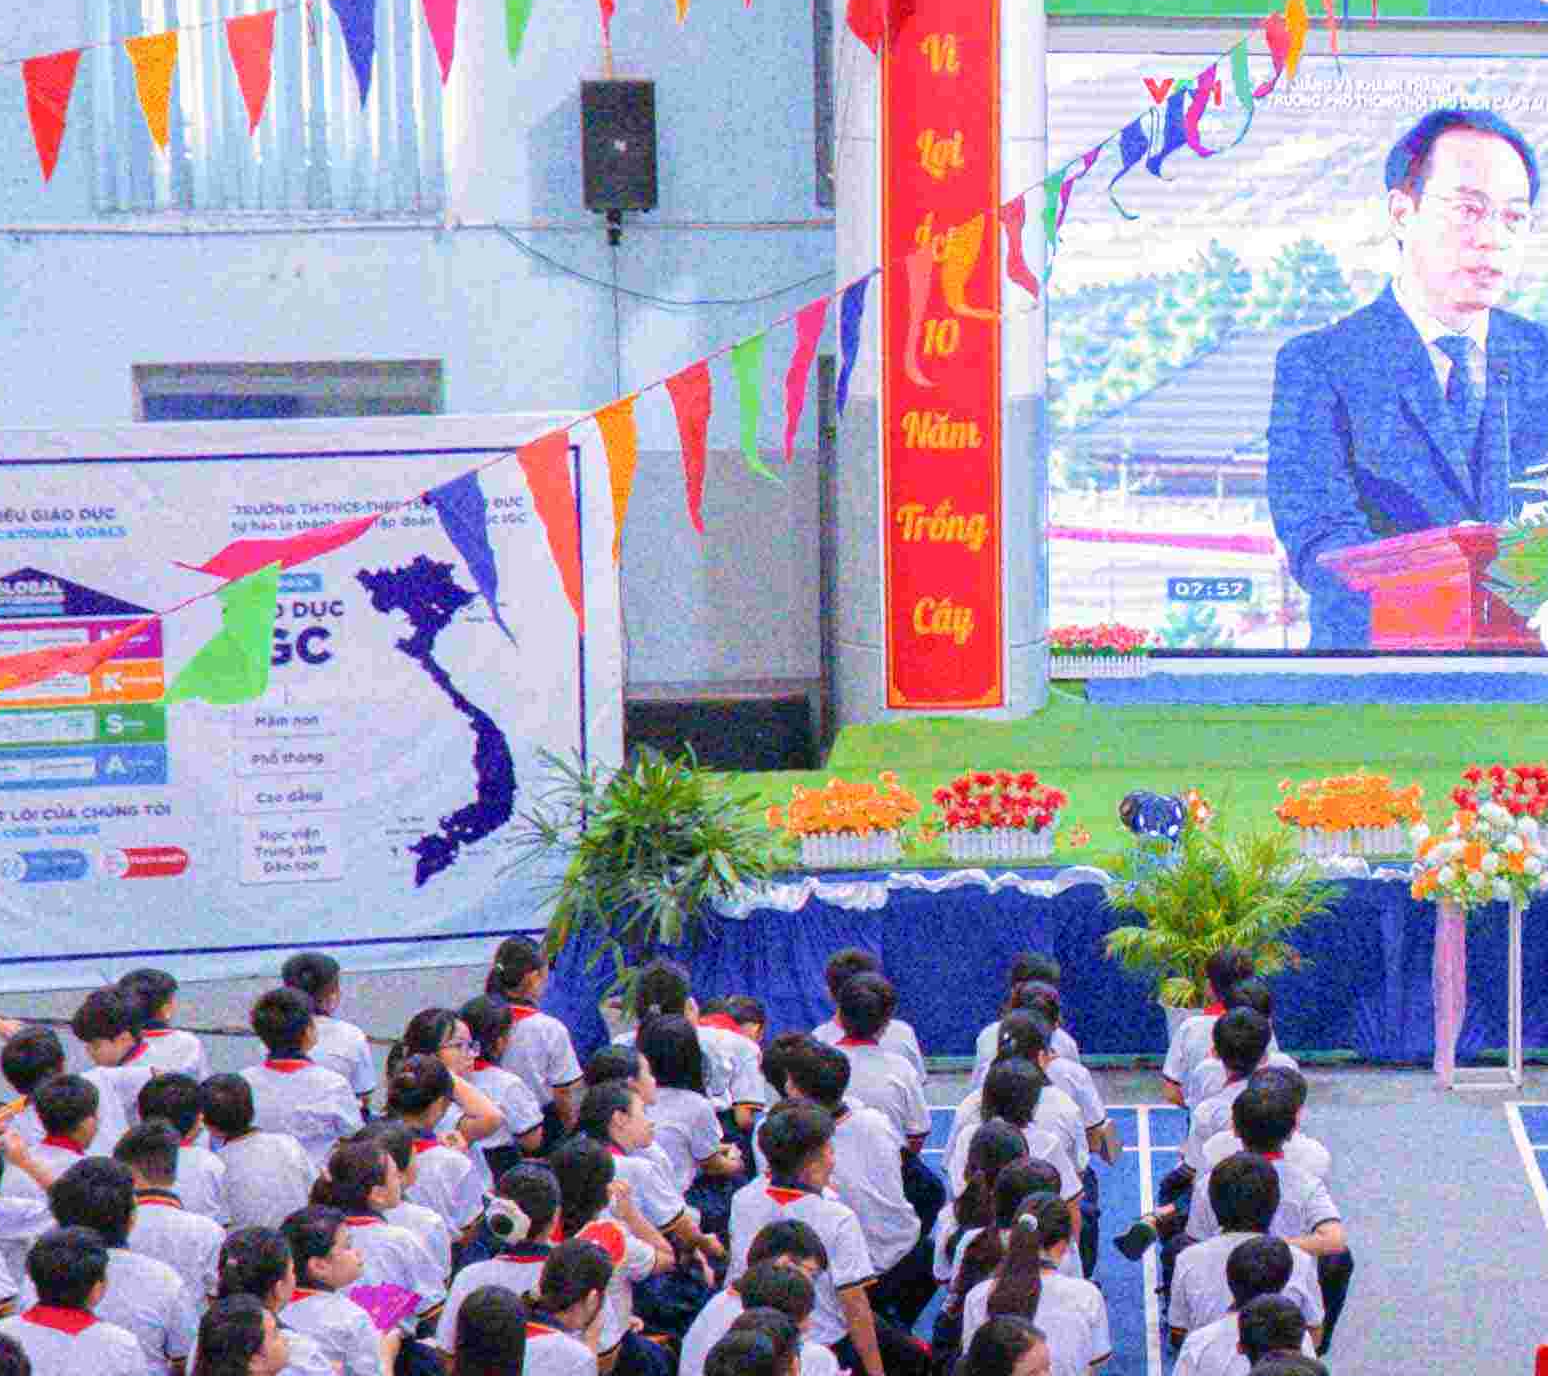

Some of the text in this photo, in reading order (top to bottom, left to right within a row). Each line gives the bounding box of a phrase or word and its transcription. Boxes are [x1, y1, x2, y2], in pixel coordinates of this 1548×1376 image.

[923, 318, 960, 356] 10
[901, 410, 982, 450] Năm
[30, 506, 75, 523] GIÁO
[1175, 580, 1245, 598] 07:57
[292, 599, 345, 623] DỤC
[914, 597, 974, 645] Cây
[271, 624, 334, 667] GC
